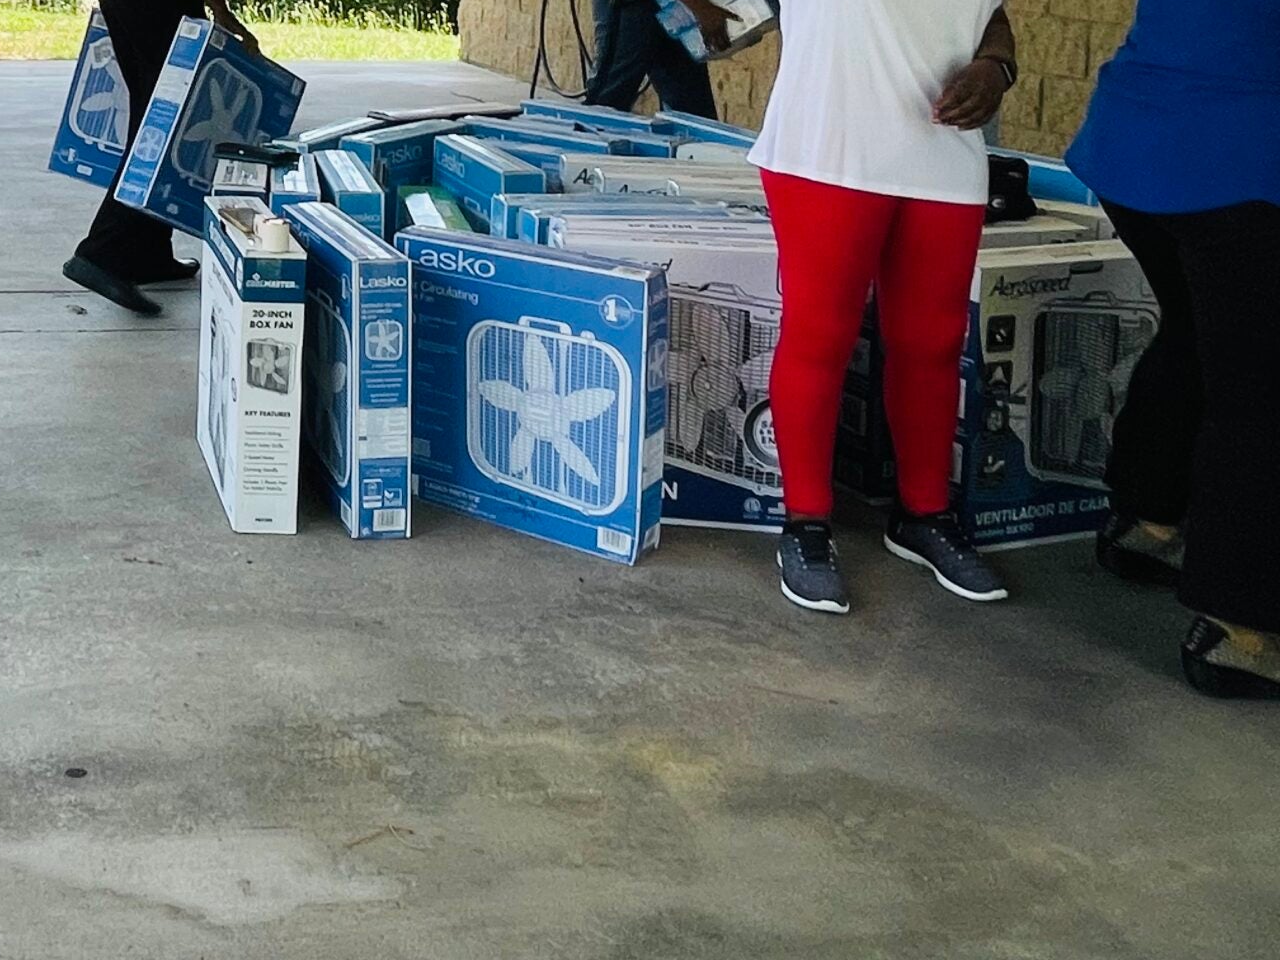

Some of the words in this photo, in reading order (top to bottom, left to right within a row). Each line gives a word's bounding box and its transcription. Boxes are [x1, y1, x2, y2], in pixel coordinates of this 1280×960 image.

[404, 239, 496, 278] Lasko
[360, 275, 407, 289] Lasko
[420, 280, 479, 306] Circulating
[988, 274, 1072, 298] Aerospeed
[252, 309, 293, 319] 20-INCH
[604, 298, 618, 323] 1
[249, 320, 271, 329] BOX
[274, 321, 294, 329] FAN
[975, 503, 1055, 526] VENTILADOR
[1058, 500, 1076, 514] DE
[1079, 495, 1112, 512] CAJA
